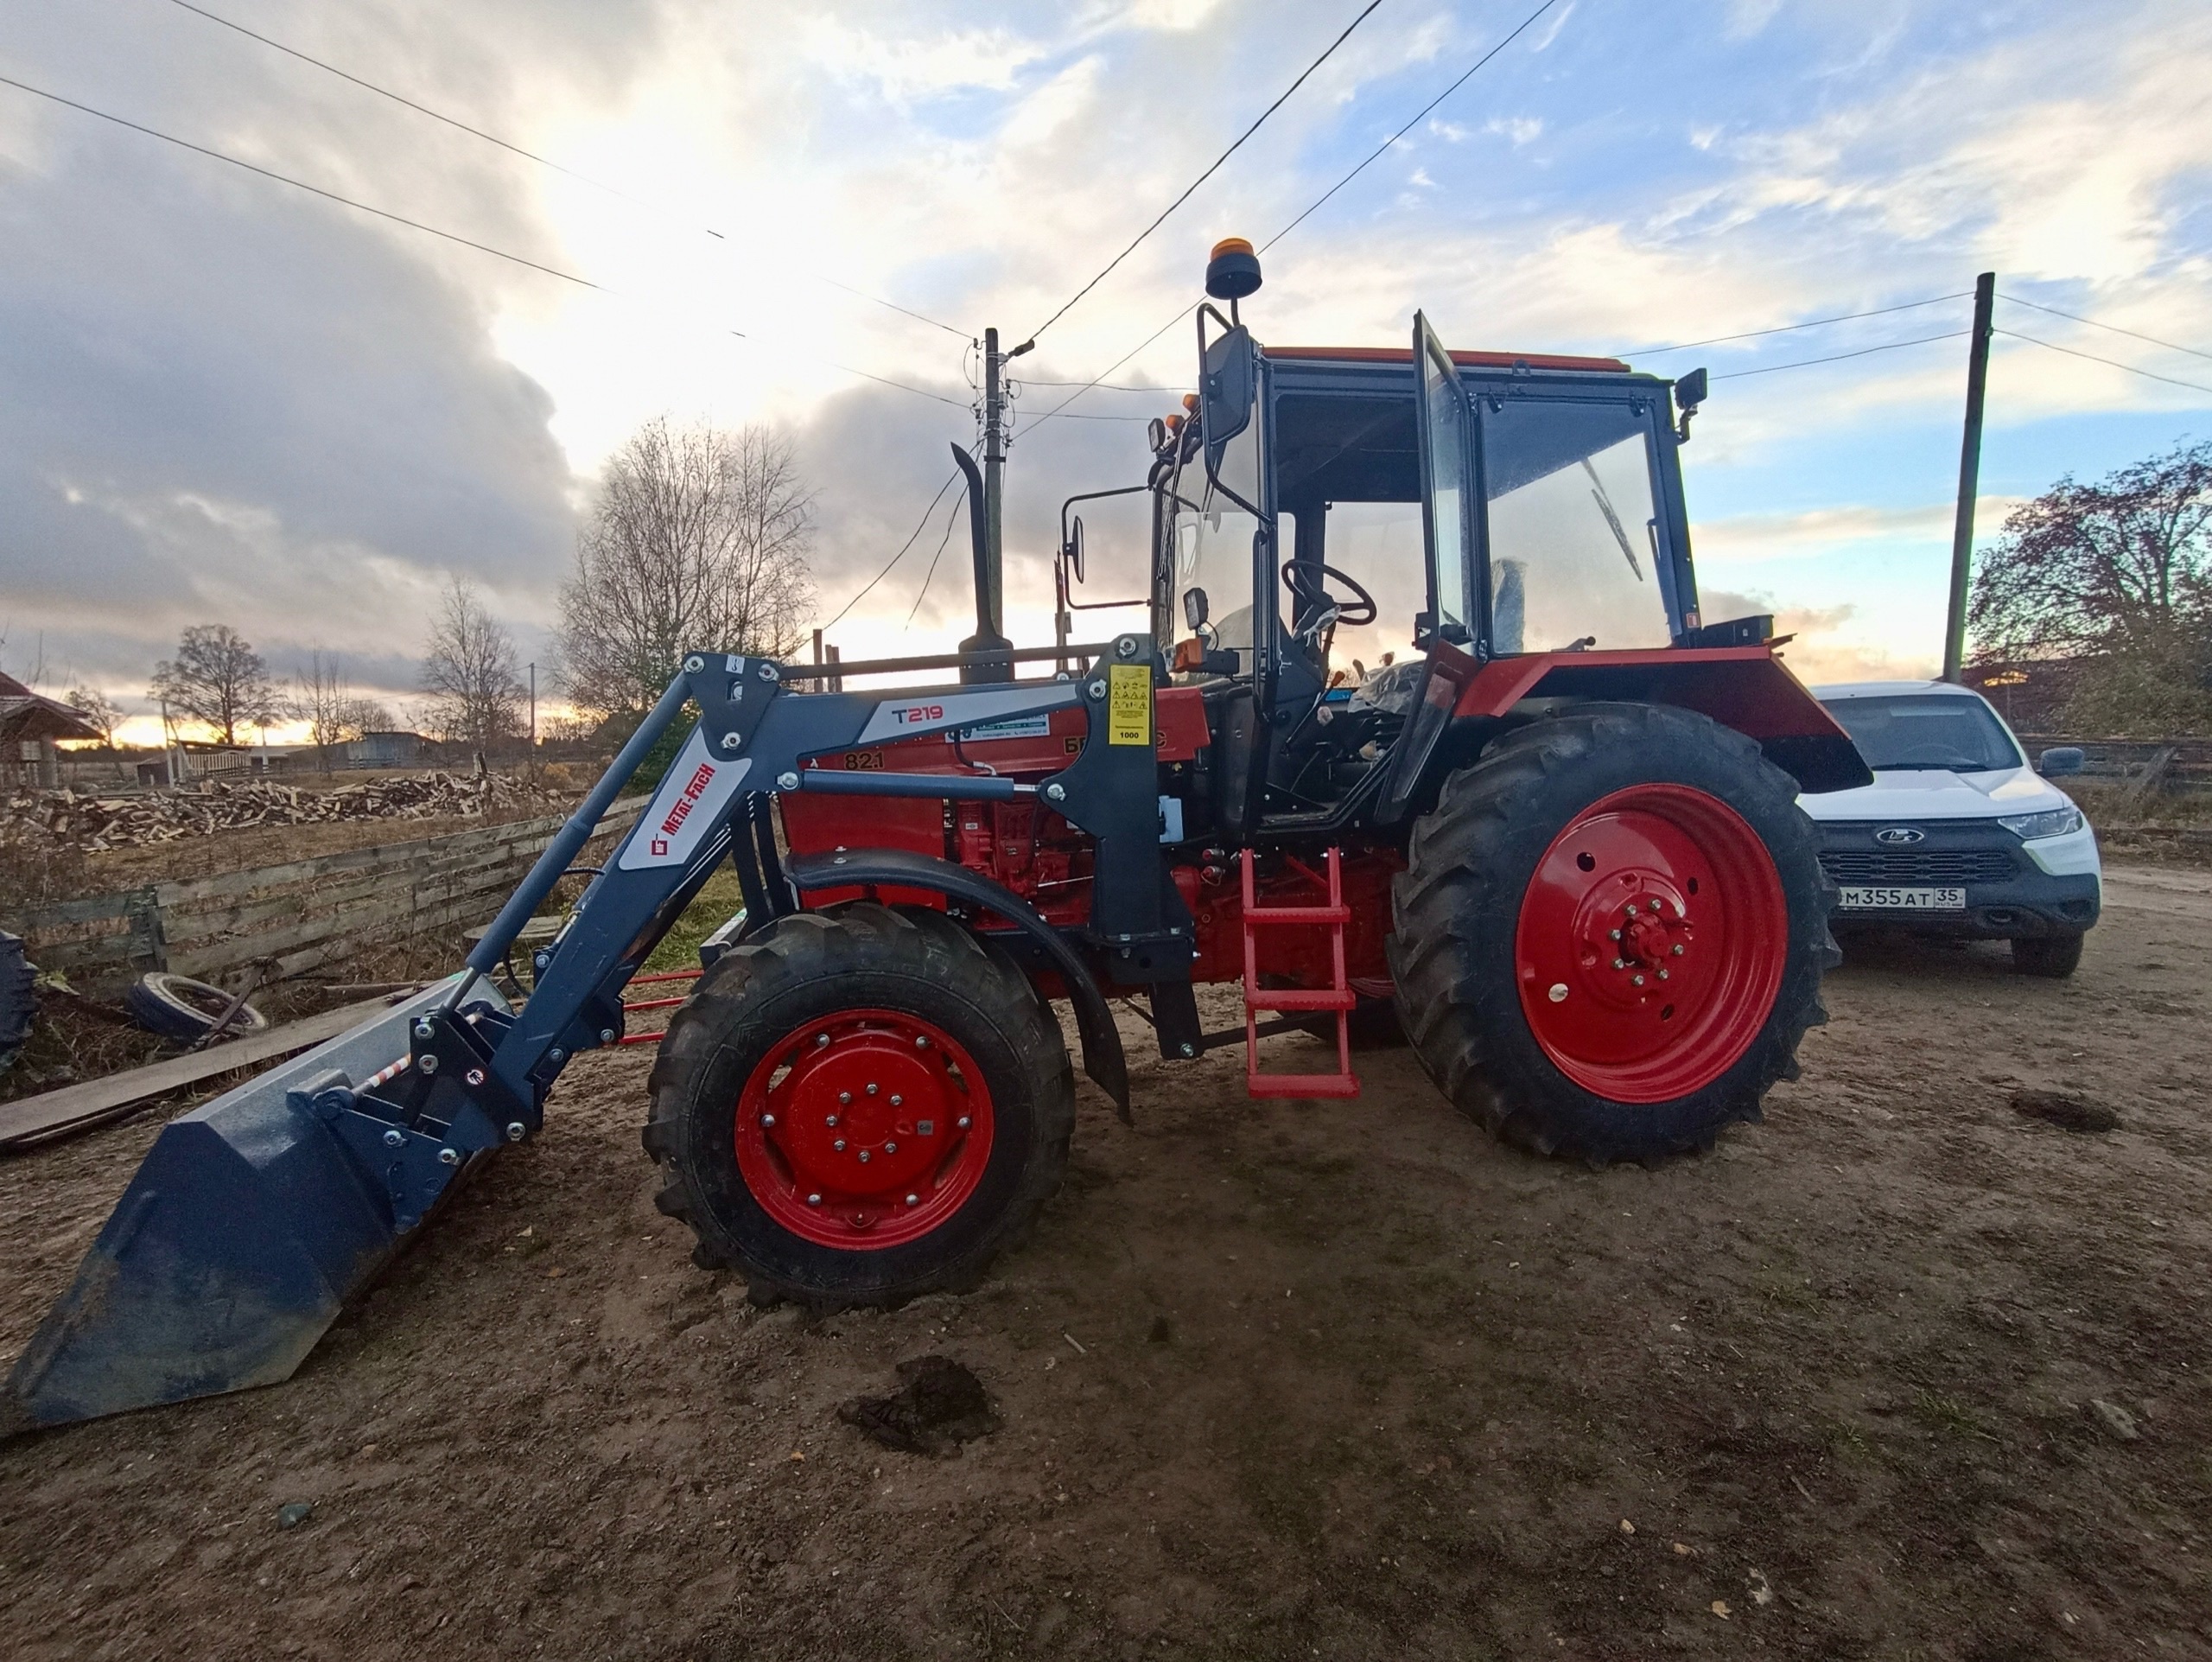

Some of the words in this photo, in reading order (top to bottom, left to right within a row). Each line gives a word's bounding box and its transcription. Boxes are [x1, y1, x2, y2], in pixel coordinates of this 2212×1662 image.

[892, 705, 944, 723] T219
[845, 752, 884, 770] 82.1
[661, 763, 715, 837] METAL-FACH
[1937, 889, 1958, 901] 35
